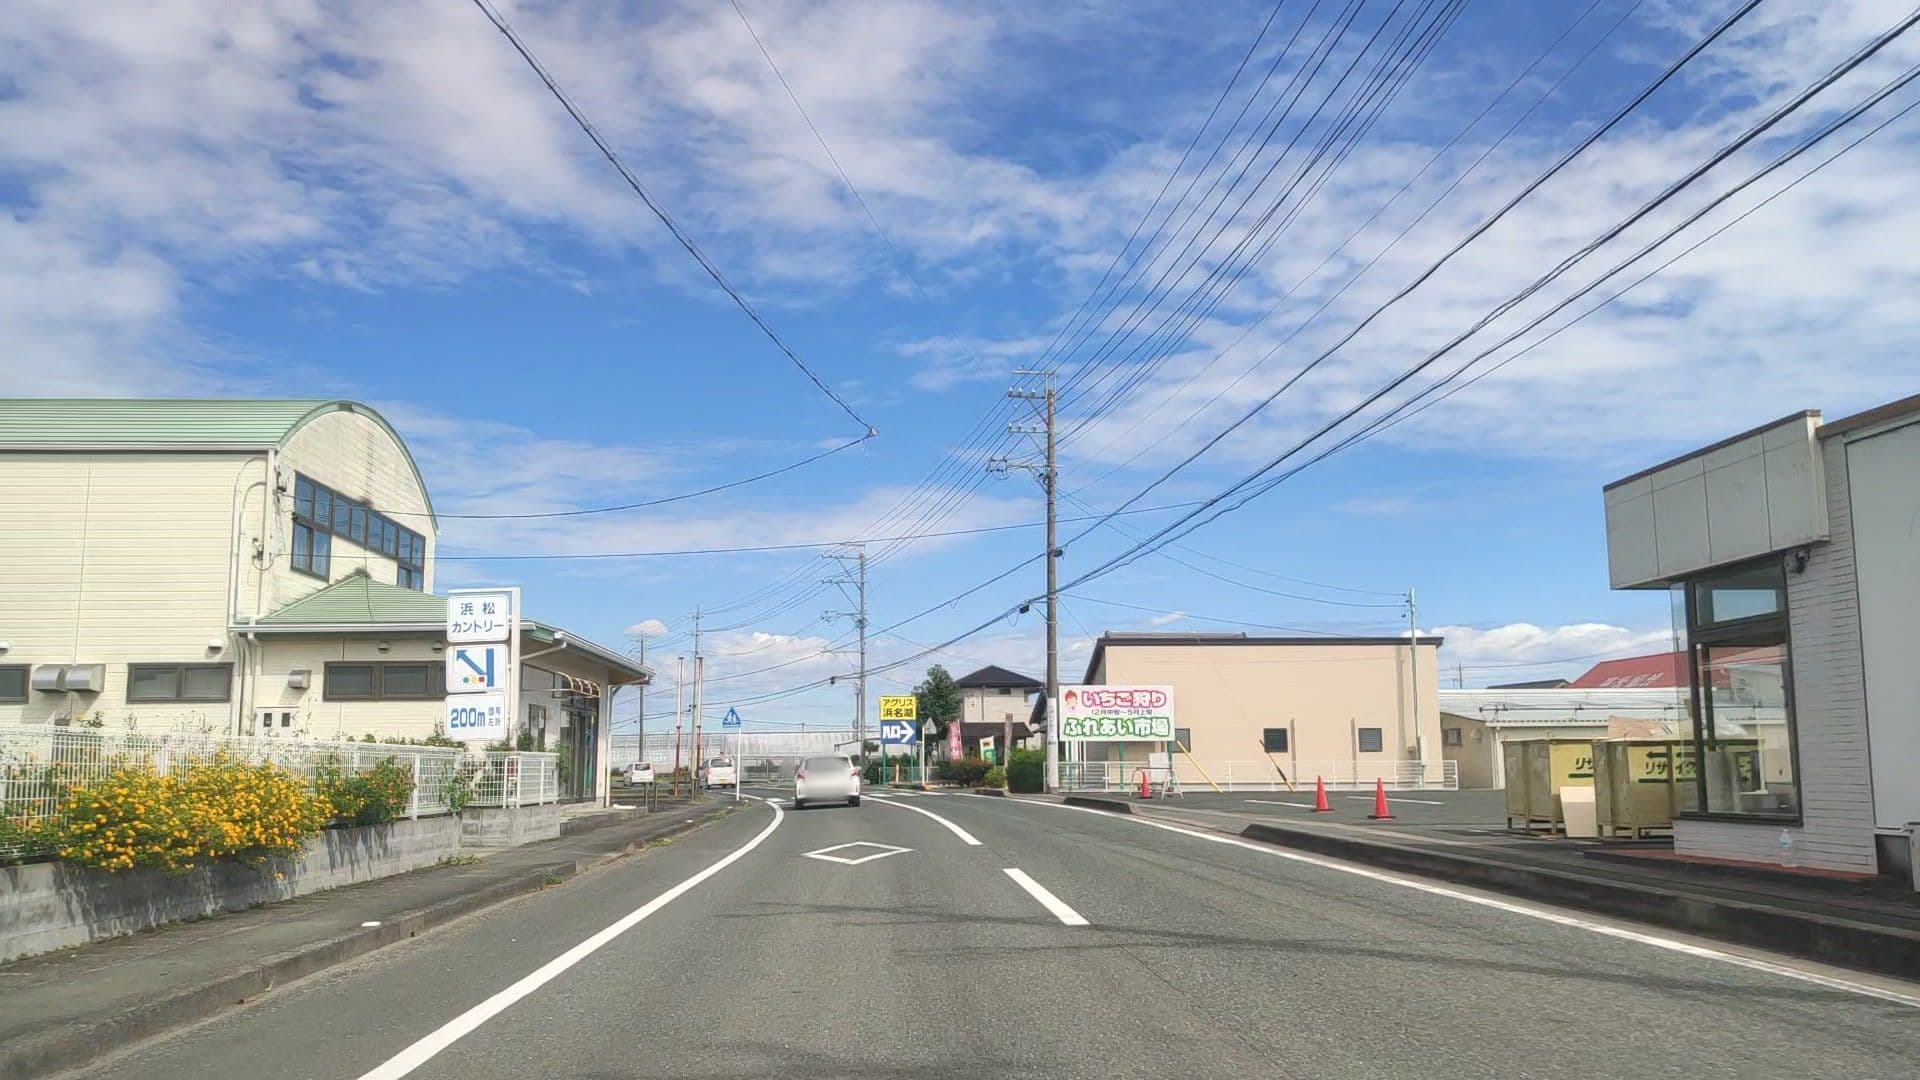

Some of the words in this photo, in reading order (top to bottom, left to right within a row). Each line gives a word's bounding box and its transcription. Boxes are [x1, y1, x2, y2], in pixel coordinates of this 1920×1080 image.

[460, 602, 496, 616] 浜松
[452, 621, 505, 633] カントリー
[882, 698, 914, 707] アグリス
[1081, 690, 1167, 708] いちご狩り
[450, 707, 486, 728] 200m
[882, 708, 914, 718] 浜名湖
[1064, 717, 1170, 736] ふれあい市場
